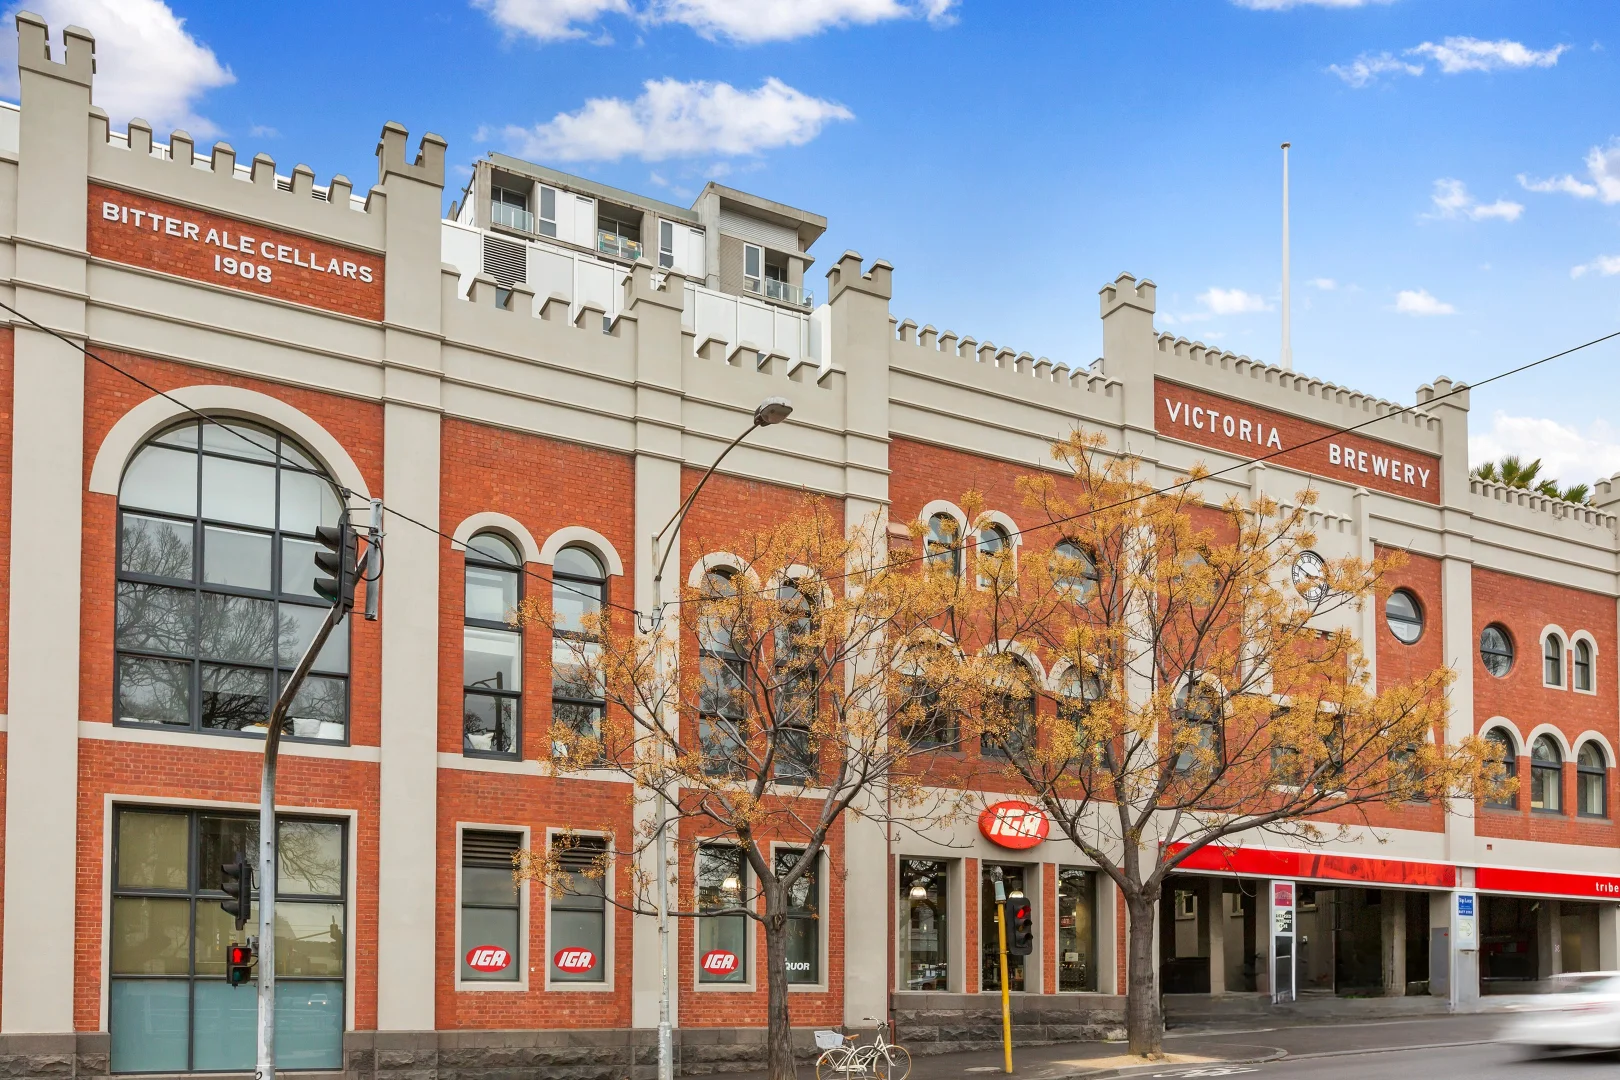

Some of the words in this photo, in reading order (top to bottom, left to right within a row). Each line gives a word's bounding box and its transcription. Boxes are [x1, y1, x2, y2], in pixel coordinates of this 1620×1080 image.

[102, 201, 200, 241] BITTER
[204, 228, 256, 255] ALE
[260, 241, 373, 283] CELLARS
[214, 254, 272, 283] 1908
[1165, 398, 1283, 451] VICTORIA
[1329, 443, 1430, 488] BREWERY
[990, 807, 1042, 838] IGA
[1595, 882, 1619, 893] tribe
[470, 949, 506, 967] IGA
[557, 951, 592, 968] IGA
[703, 953, 735, 970] IGA
[785, 961, 810, 971] QUOR
